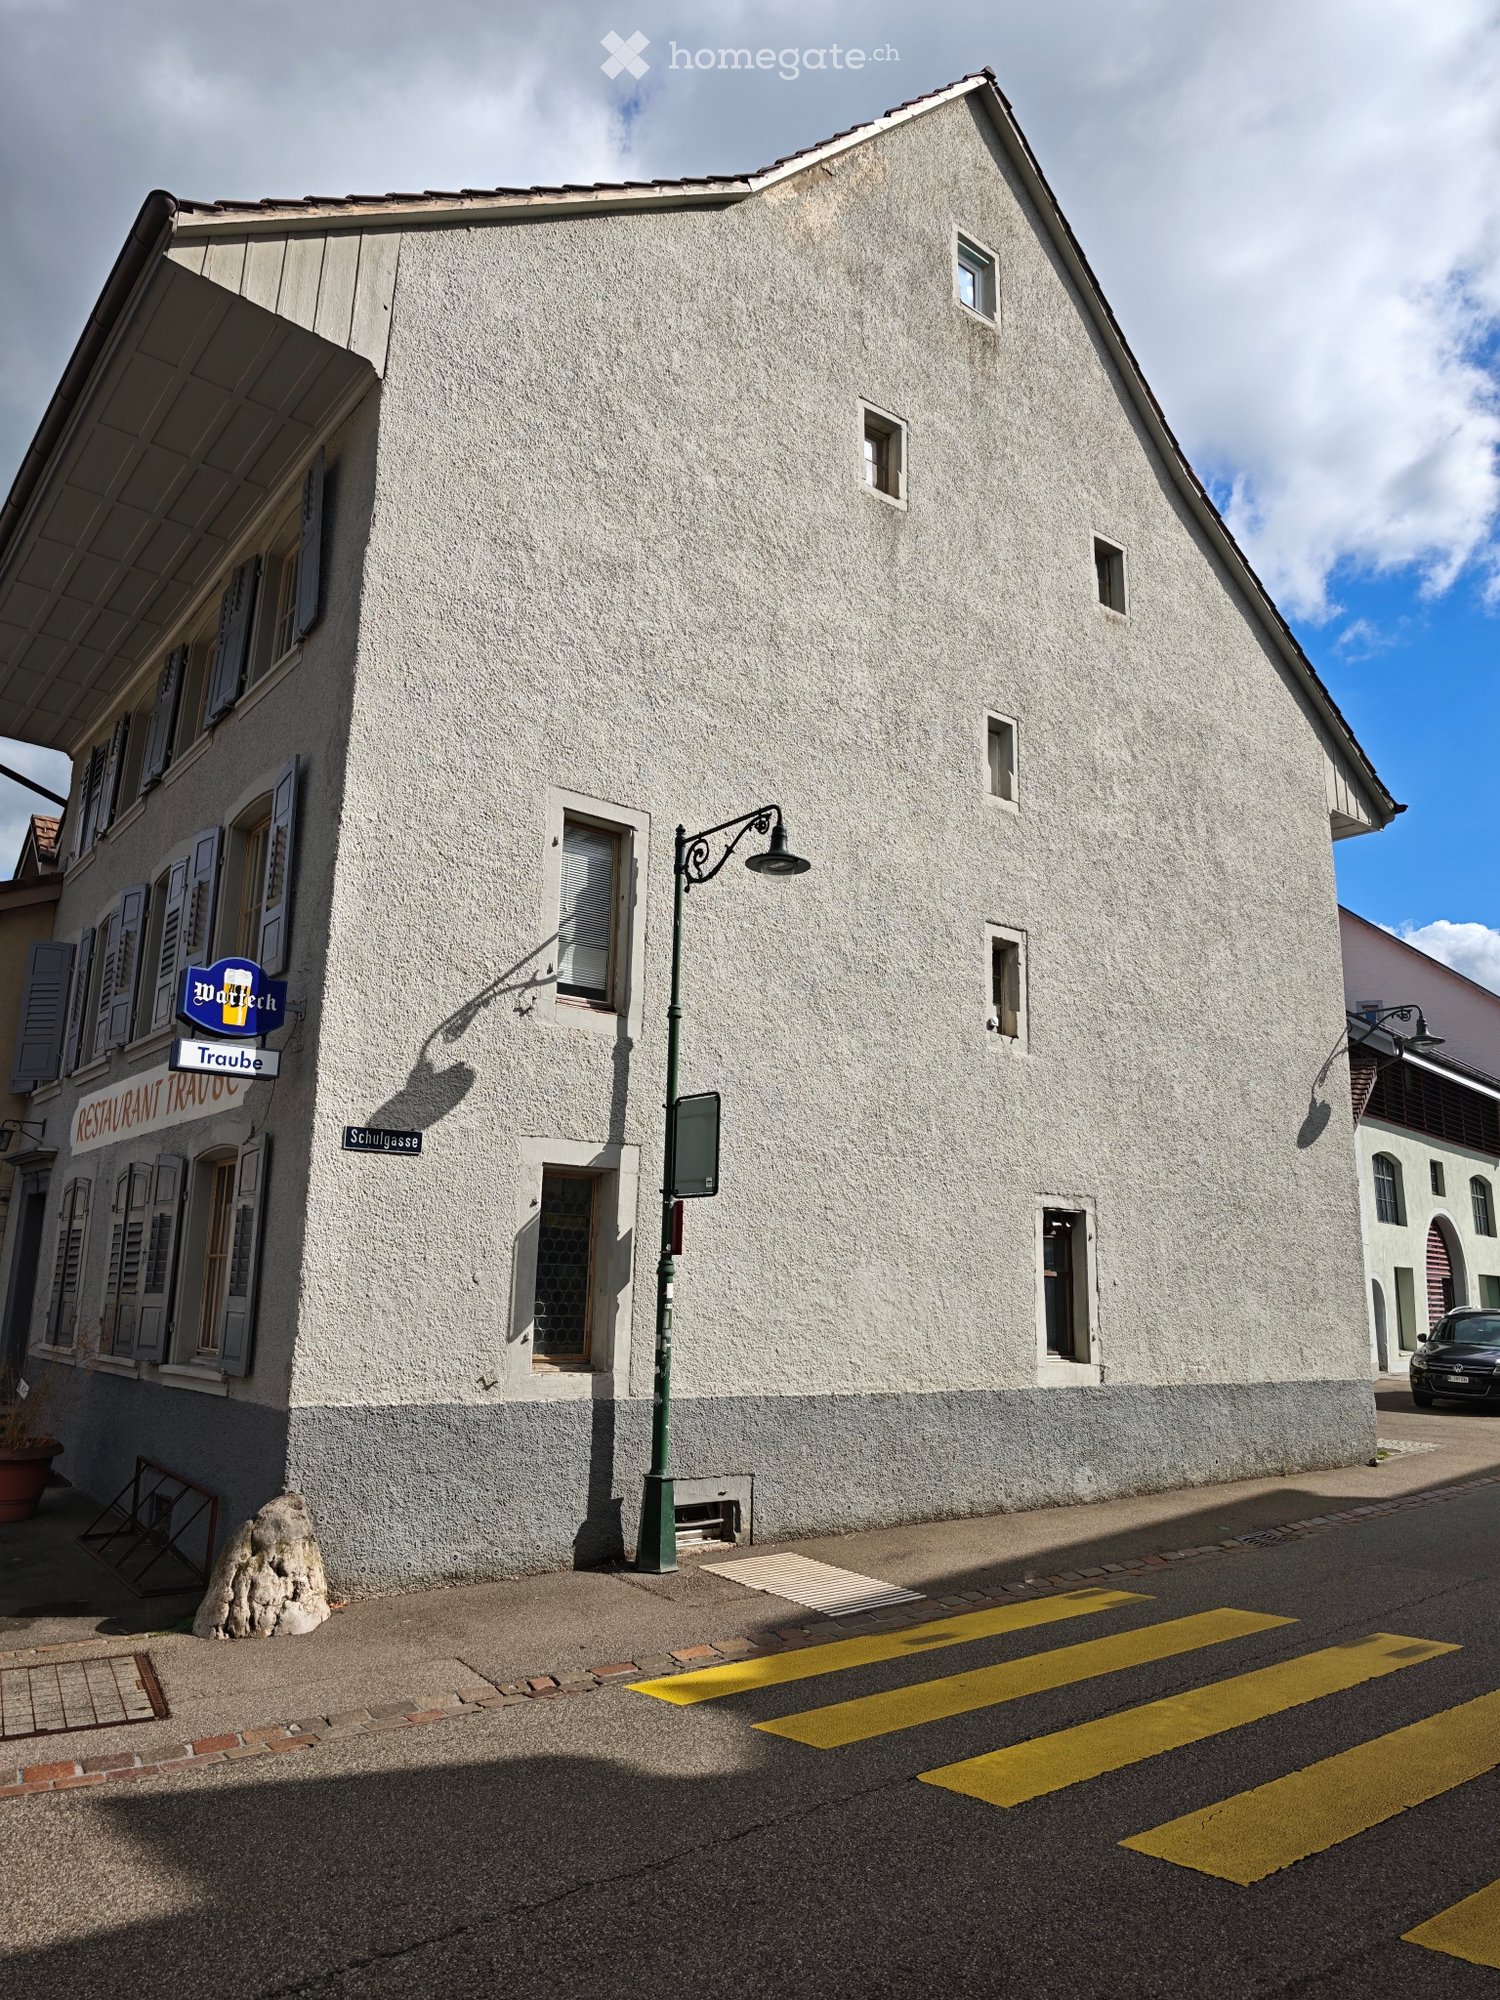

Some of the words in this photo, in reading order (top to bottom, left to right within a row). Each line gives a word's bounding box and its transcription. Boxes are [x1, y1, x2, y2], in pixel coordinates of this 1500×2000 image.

[193, 981, 277, 1011] Warteck
[198, 1047, 263, 1070] Traube
[76, 1079, 163, 1143] RESTAURANT
[350, 1129, 418, 1149] Schulgasse
